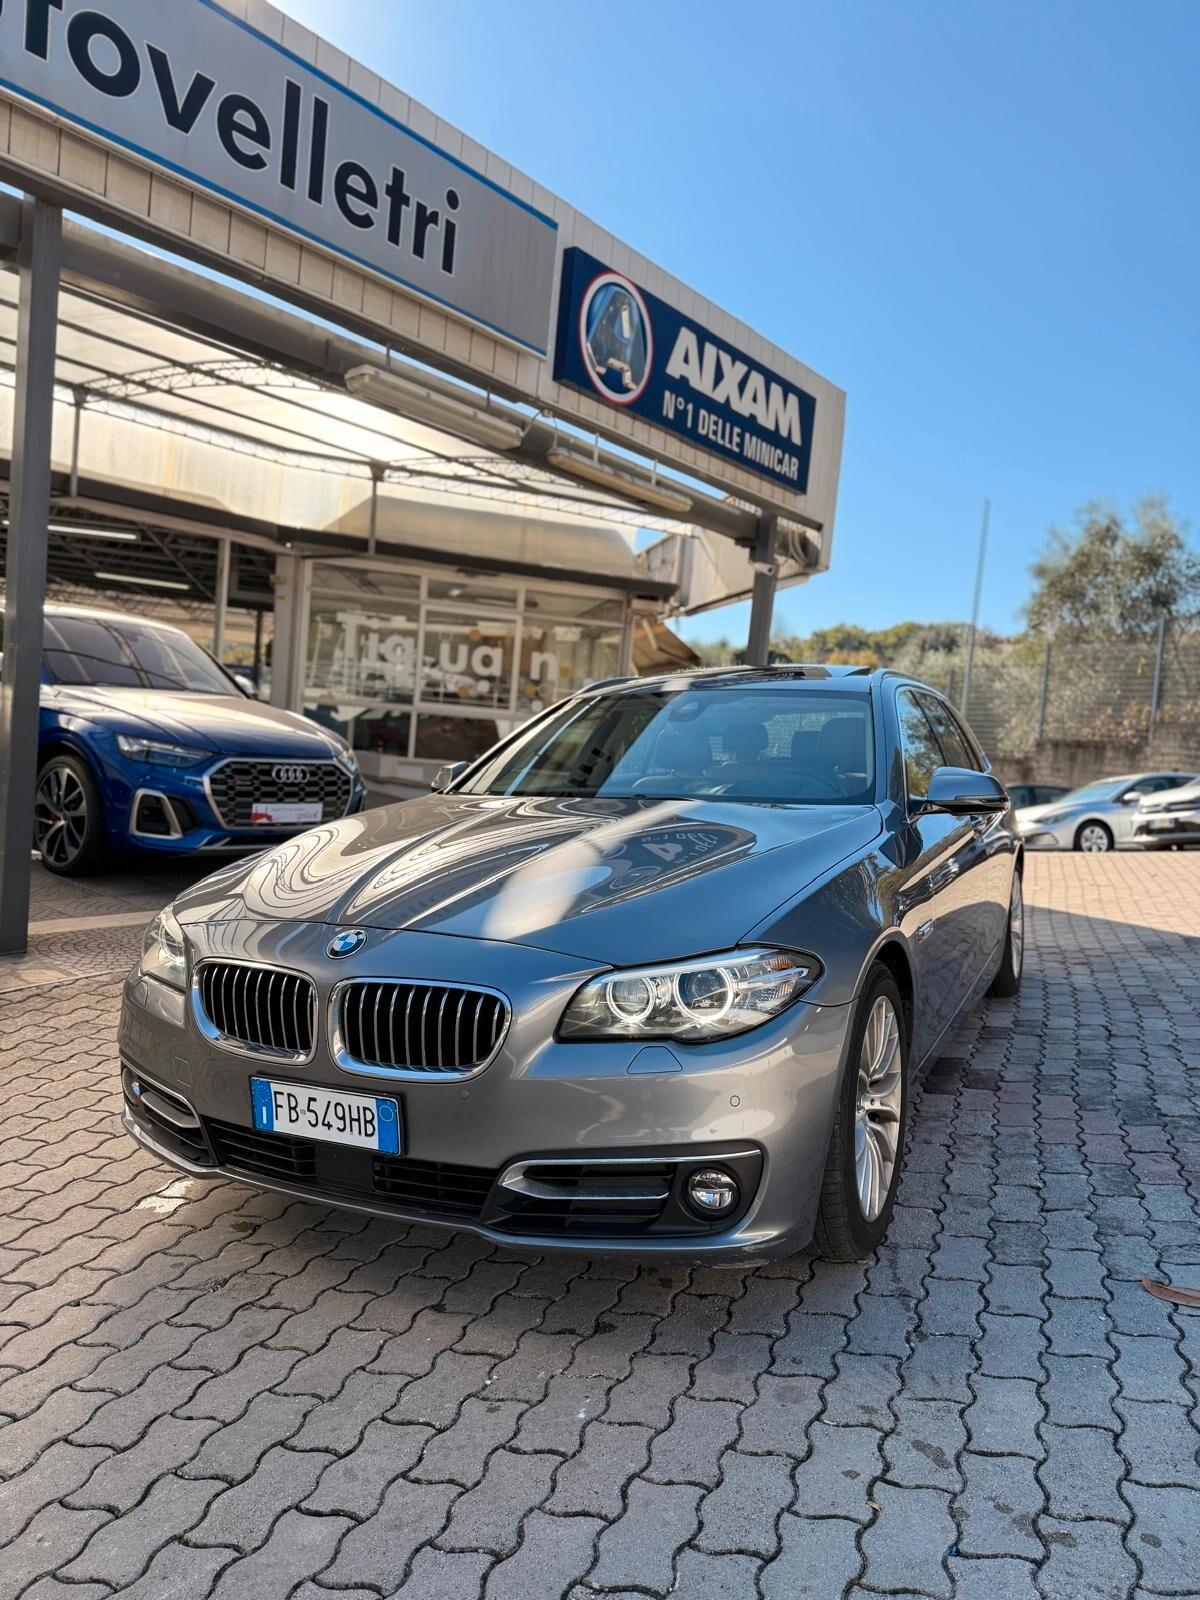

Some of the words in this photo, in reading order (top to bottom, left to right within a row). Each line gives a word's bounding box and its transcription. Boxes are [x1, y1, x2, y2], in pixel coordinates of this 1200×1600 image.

[665, 326, 802, 446] AIXAM
[698, 408, 742, 453] DELLE
[744, 432, 799, 481] MINICAR
